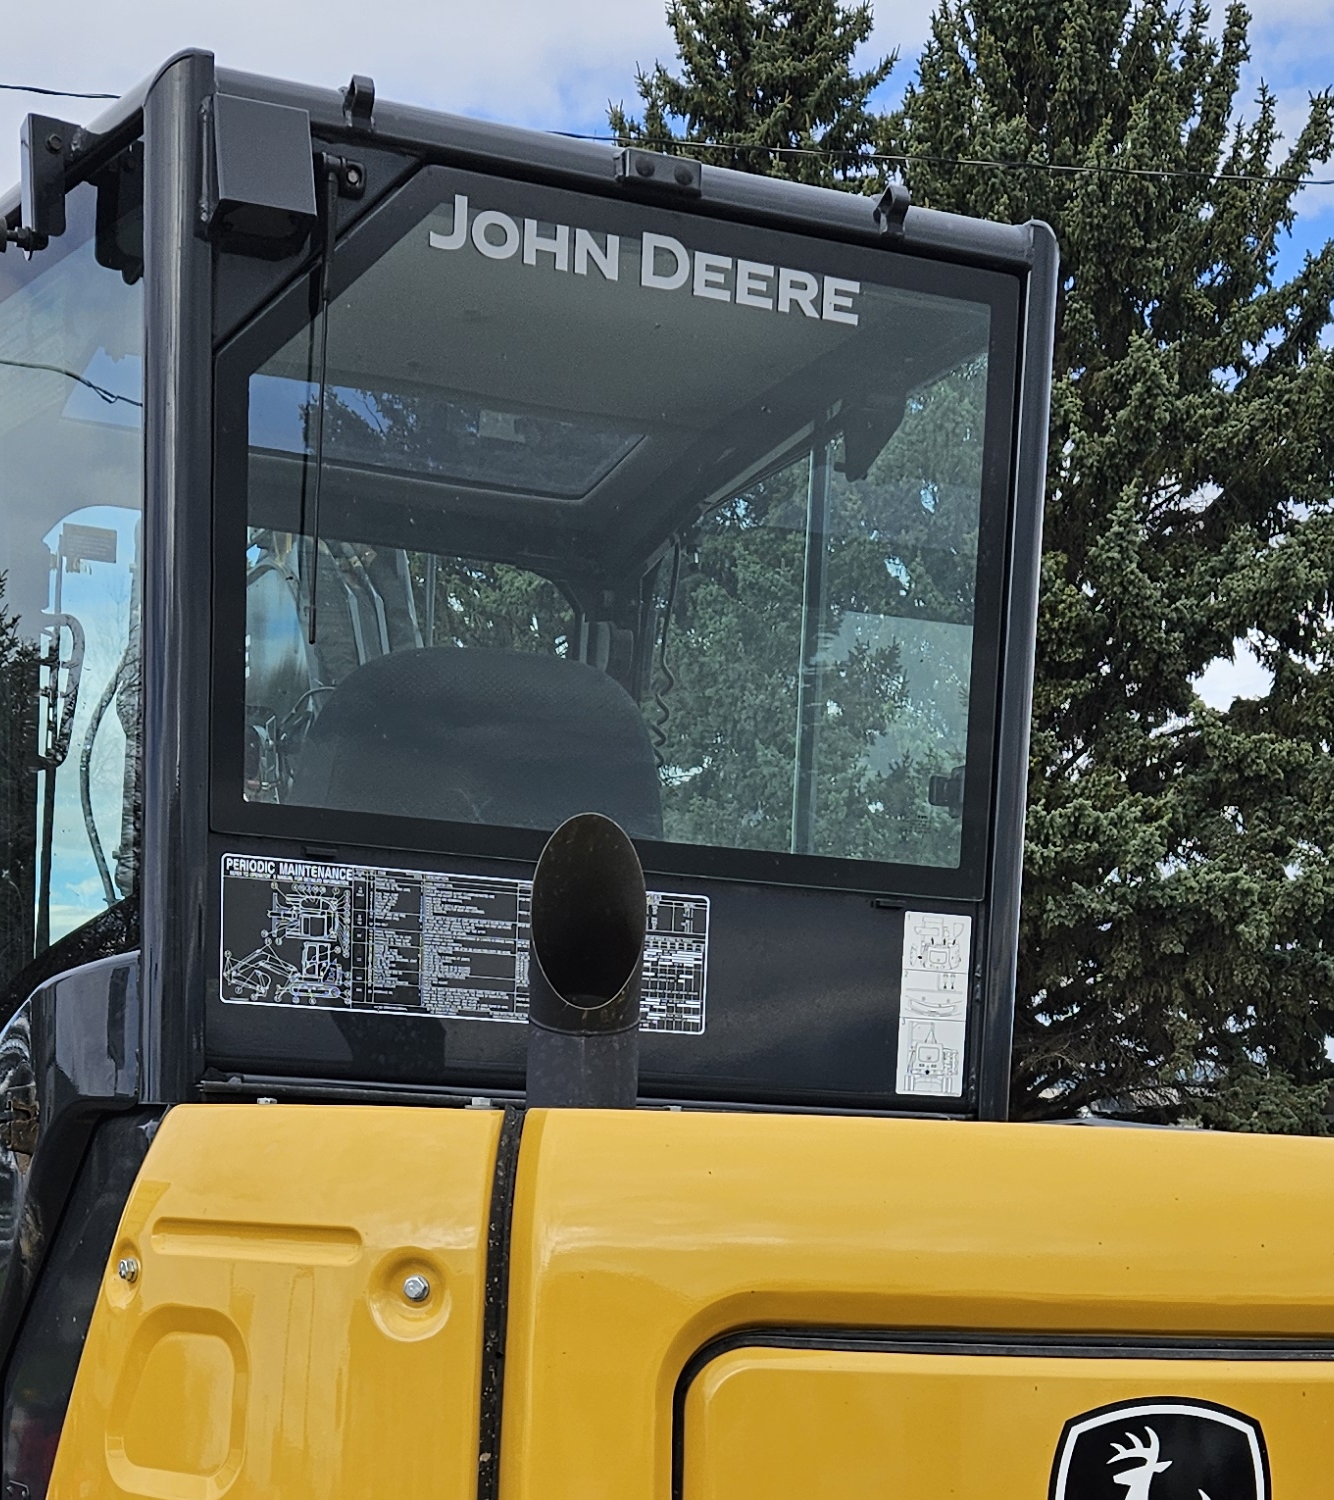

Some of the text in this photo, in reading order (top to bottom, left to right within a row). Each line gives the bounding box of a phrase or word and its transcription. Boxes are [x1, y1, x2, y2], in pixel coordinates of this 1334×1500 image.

[429, 193, 861, 326] JOHN DEERE
[226, 858, 275, 874] PERIODIC
[279, 862, 353, 881] MAINTENANCE
